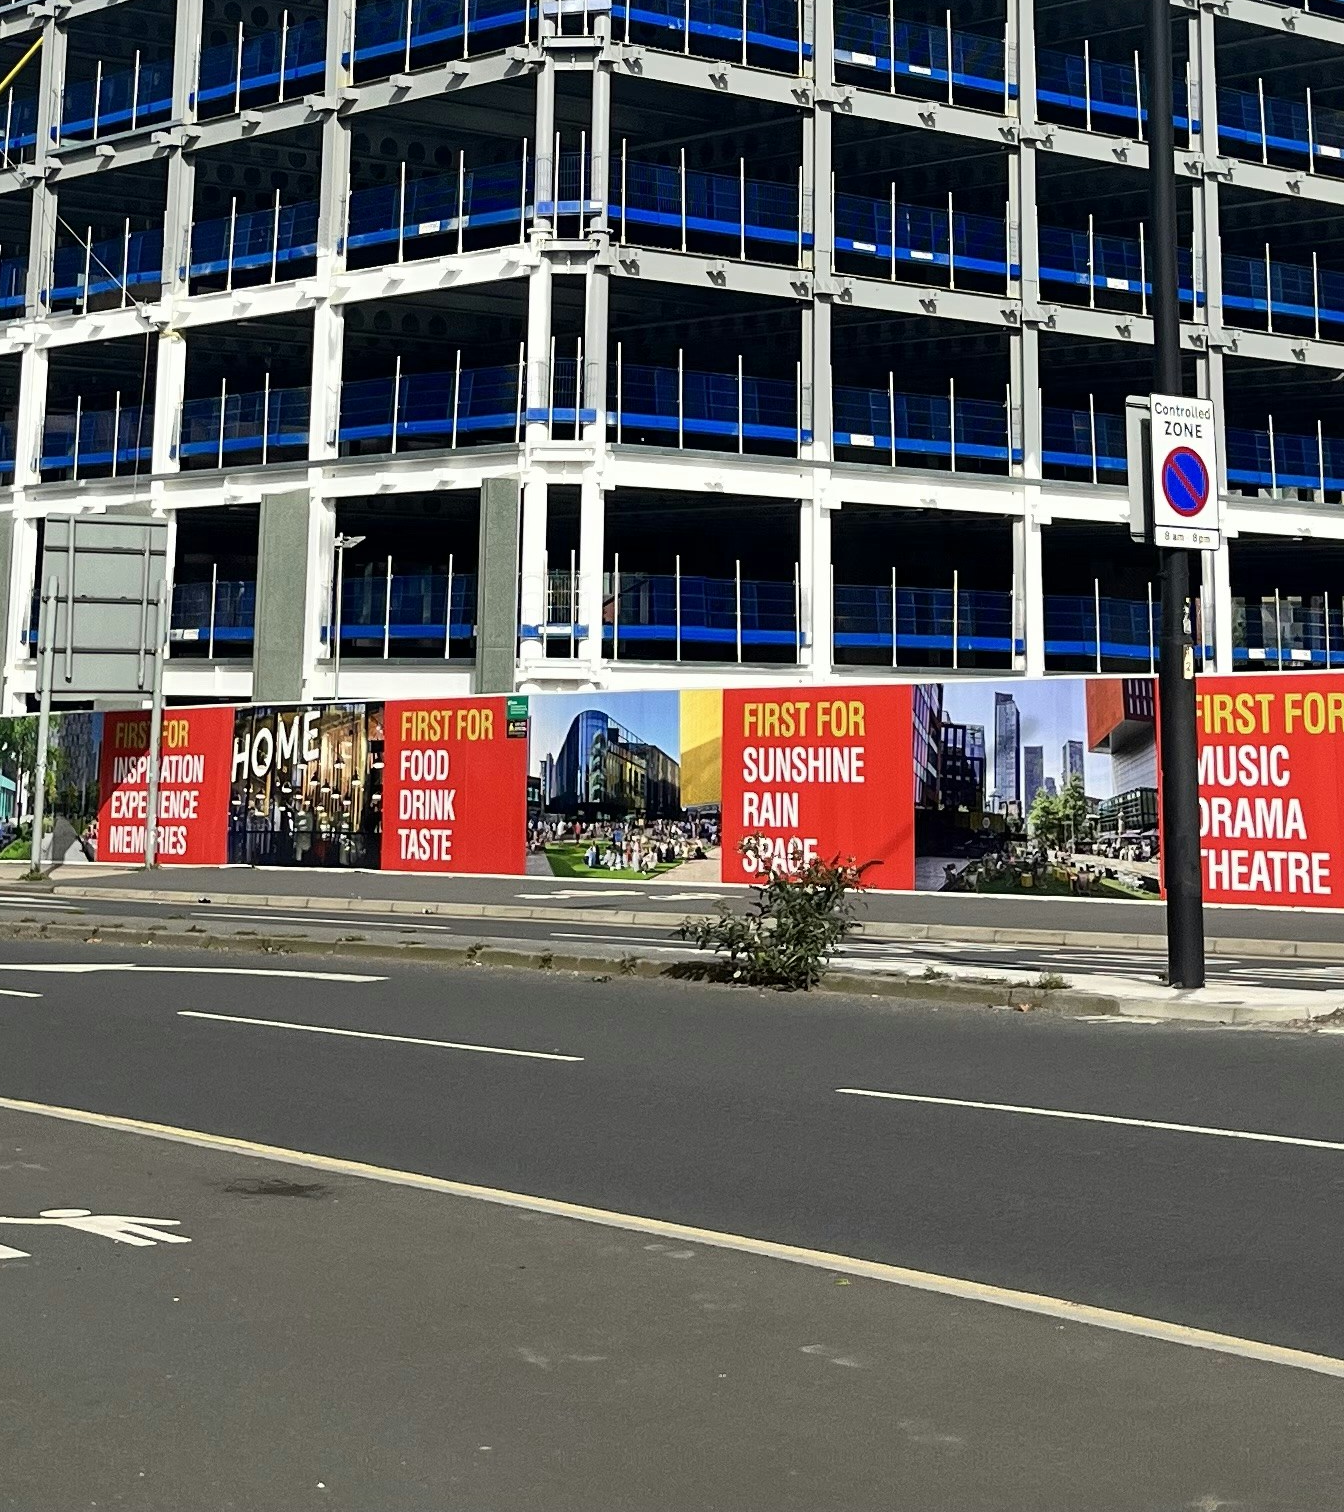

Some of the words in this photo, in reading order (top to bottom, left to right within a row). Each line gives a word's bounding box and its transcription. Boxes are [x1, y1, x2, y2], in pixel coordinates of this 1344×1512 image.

[1155, 402, 1211, 420] Controlled
[1164, 421, 1203, 439] ZONE
[115, 721, 151, 749] FIRS
[401, 710, 452, 742] FIRST
[457, 708, 494, 741] FOR
[743, 702, 811, 738] FIRST
[816, 700, 866, 737] FOR
[231, 710, 321, 783] HOME
[400, 749, 449, 782] FOOD
[742, 746, 865, 783] SUNSHINE
[111, 790, 199, 819] EXPEIENCE
[399, 789, 456, 821] DRINK
[742, 791, 799, 828] RAIN
[110, 826, 187, 855] MEMRIES
[397, 828, 453, 861] TASTE
